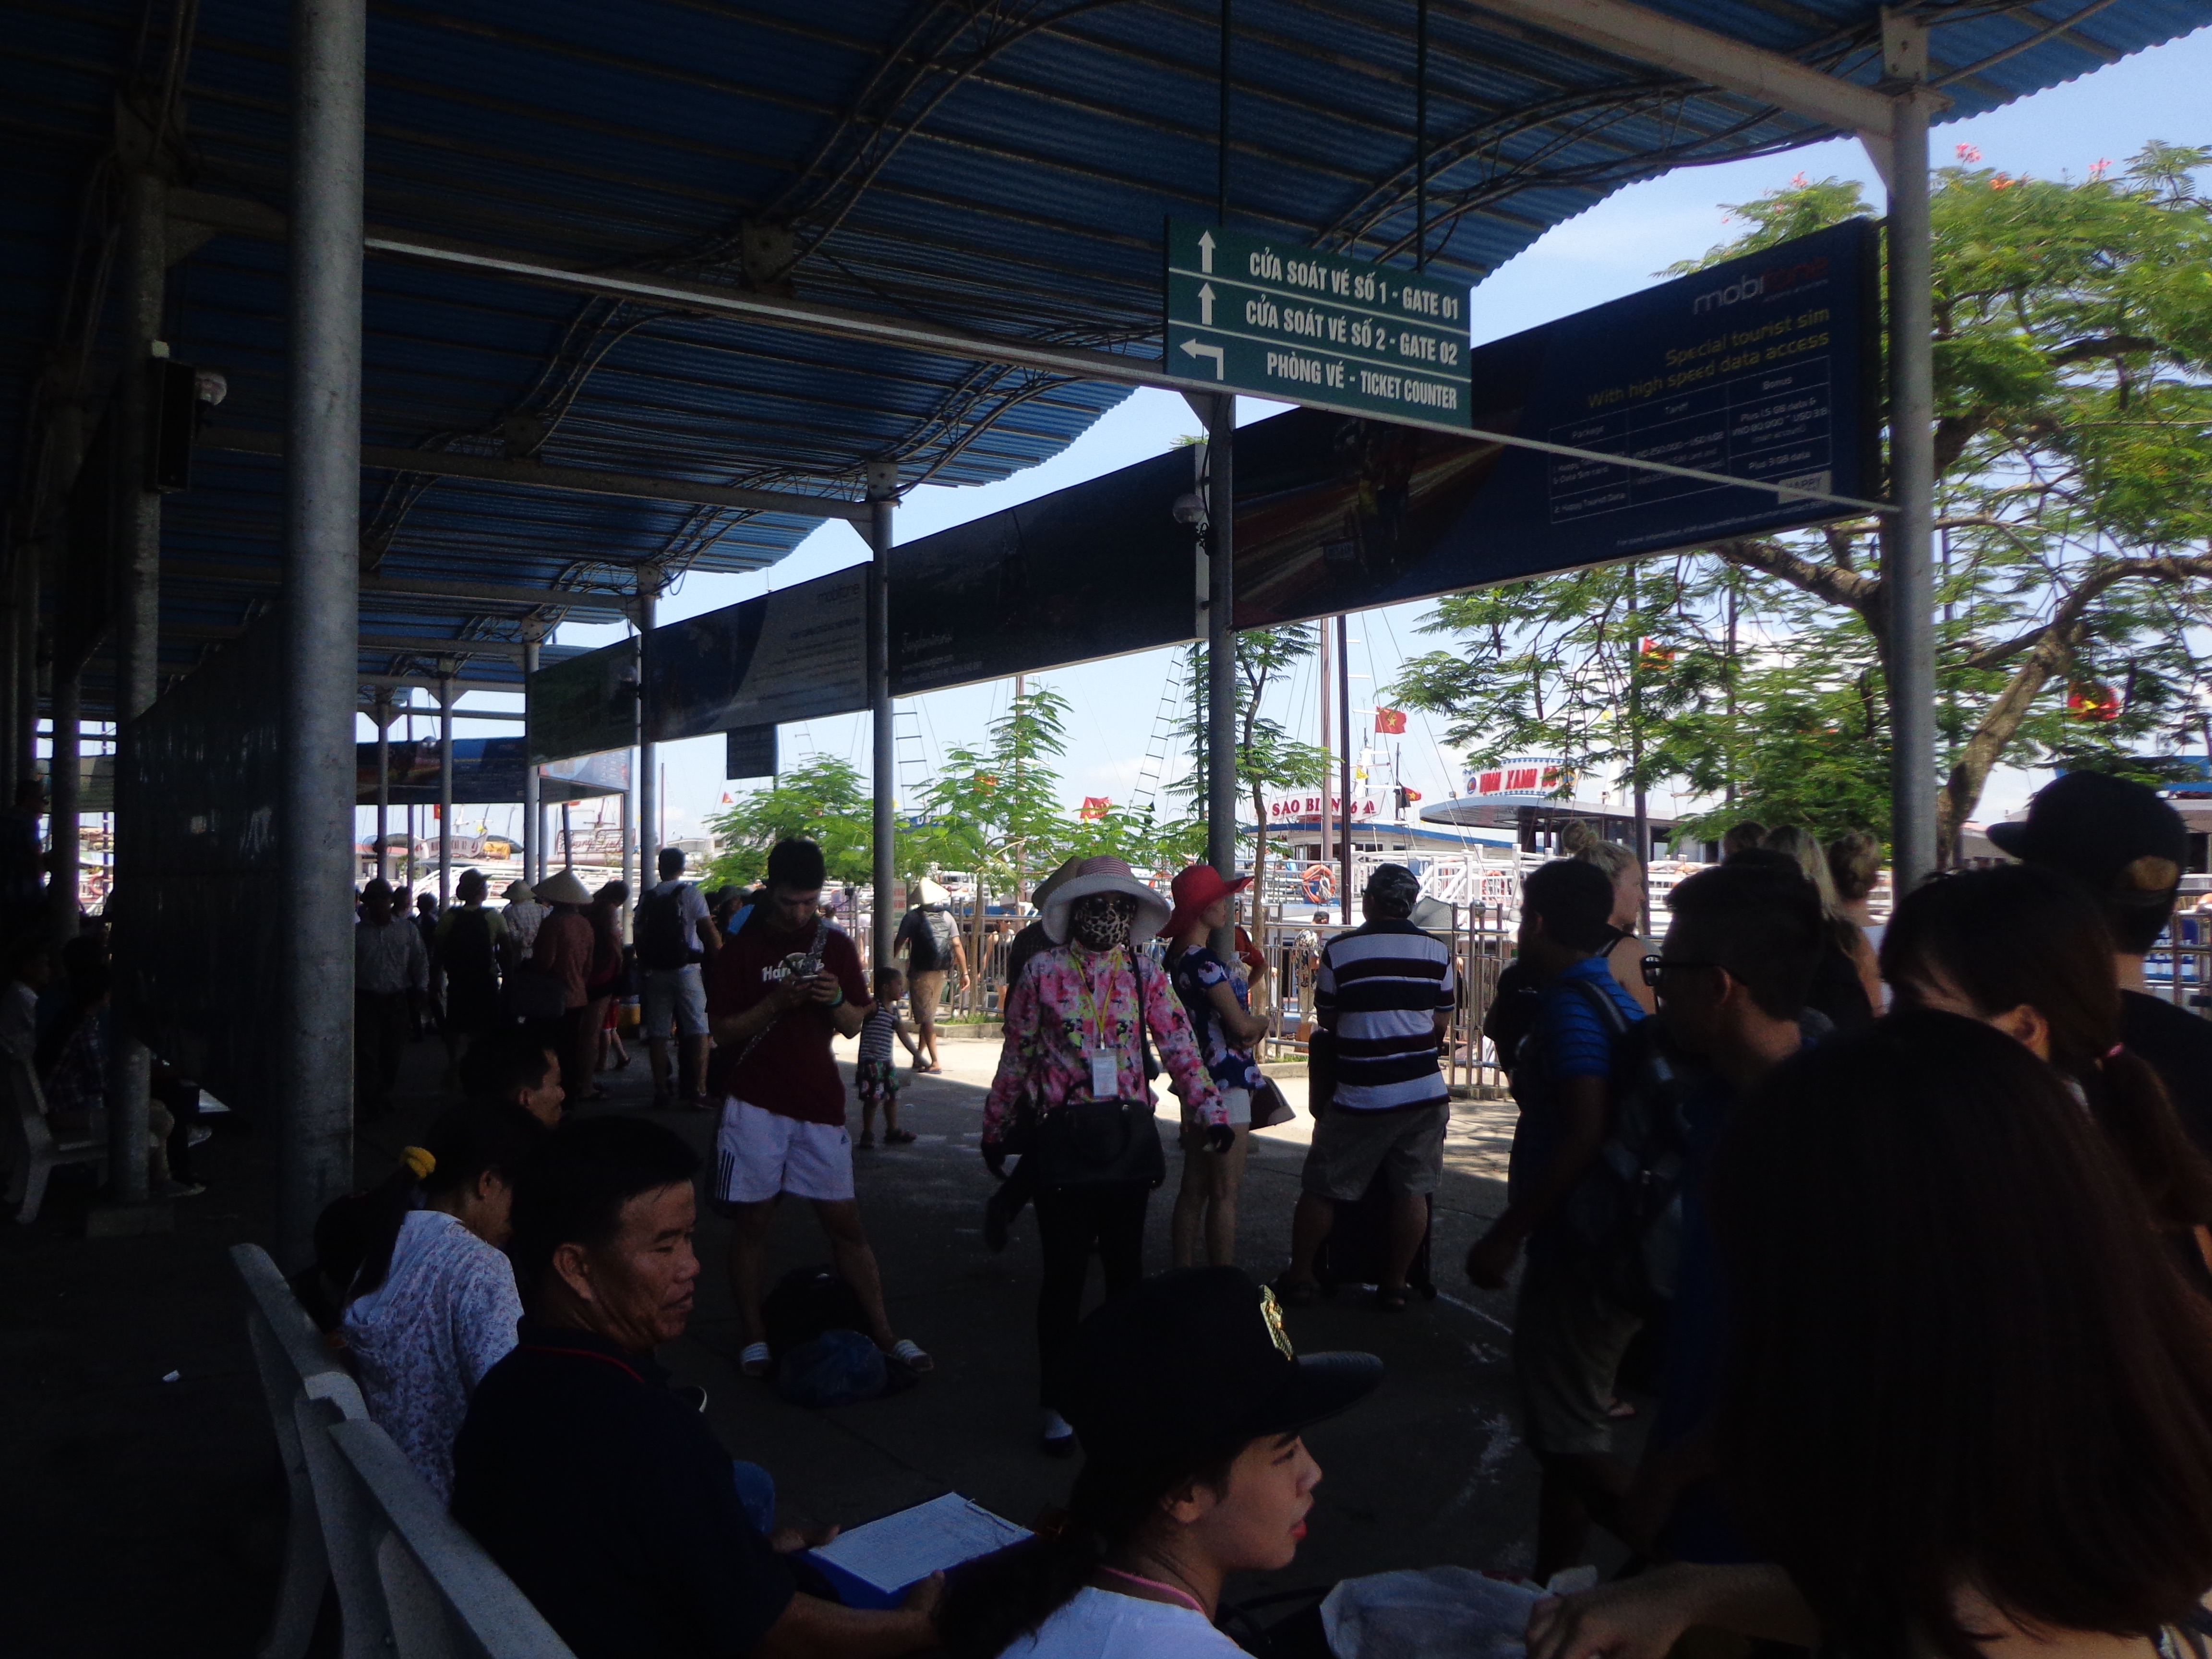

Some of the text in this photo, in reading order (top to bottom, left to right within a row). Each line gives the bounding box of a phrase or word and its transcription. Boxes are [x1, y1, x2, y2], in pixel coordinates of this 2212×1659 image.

[1250, 247, 1282, 281] CỬA
[1287, 261, 1326, 289] SOÁT
[1331, 270, 1349, 296] VÉ
[1355, 272, 1375, 301] SỐ
[1379, 282, 1386, 303] 1
[1403, 287, 1439, 316] GATE
[1443, 296, 1459, 320] 01
[1246, 293, 1278, 329] CỬA
[1284, 308, 1323, 338] SOÁT
[1328, 316, 1346, 343] VÉ
[1351, 318, 1372, 348] SỐ
[1375, 328, 1386, 350] 2
[1400, 332, 1436, 361] GATE
[1440, 342, 1457, 366] 02
[1664, 307, 1830, 367] Special tourist sim
[1267, 349, 1321, 384] PHÒNG
[1326, 360, 1344, 389] VÉ
[1360, 371, 1400, 399] TICKET
[1404, 379, 1457, 409] COUNTER
[1587, 331, 1830, 409] With high speed data access
[1272, 800, 1300, 816] SAO
[1305, 797, 1341, 812] BIN
[1505, 768, 1538, 790] XANH
